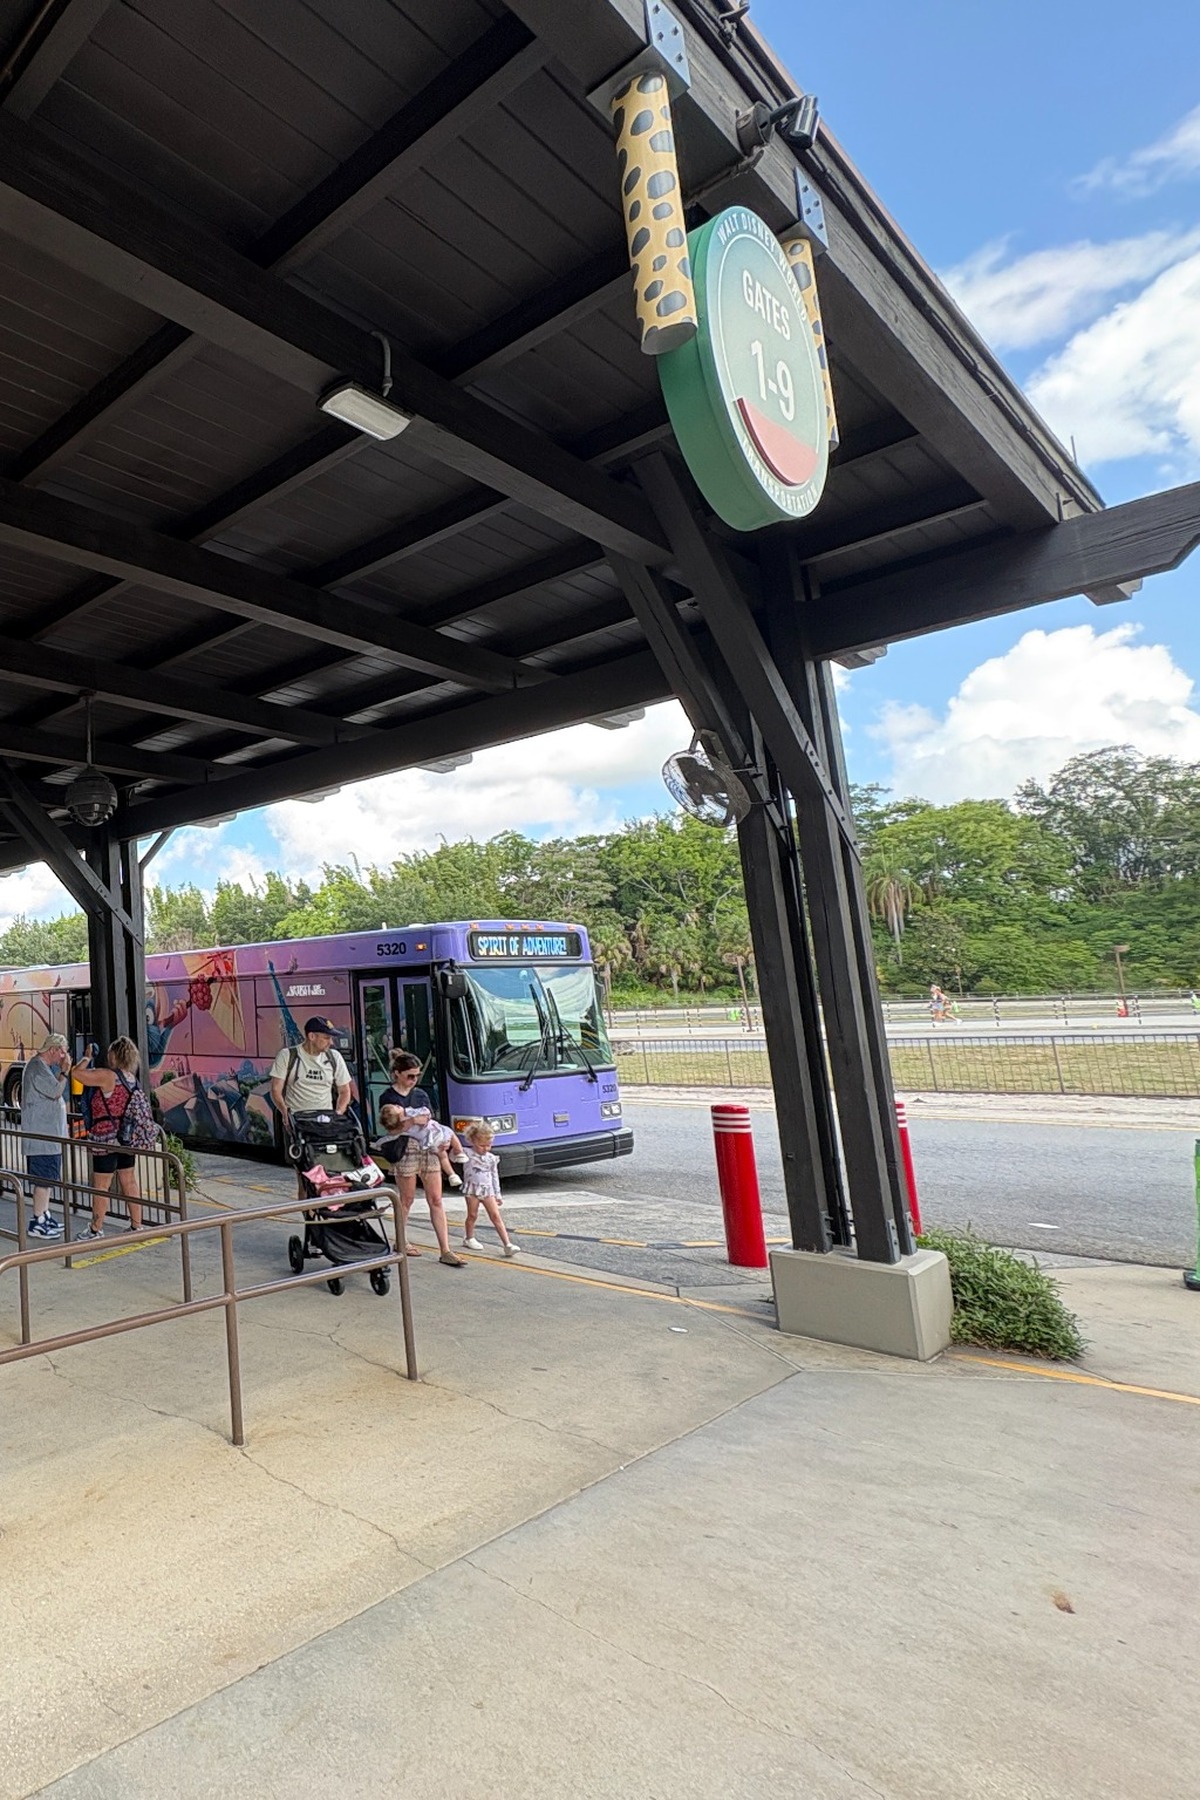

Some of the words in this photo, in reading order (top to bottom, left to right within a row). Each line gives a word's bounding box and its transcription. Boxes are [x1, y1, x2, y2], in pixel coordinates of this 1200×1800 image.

[717, 213, 740, 245] WALT
[741, 212, 776, 252] DISNEY
[779, 252, 808, 321] WORLD
[742, 270, 791, 340] GATES
[751, 340, 795, 422] 1-9
[742, 436, 818, 512] TRANSPORTATION
[377, 942, 407, 956] 5320
[478, 936, 507, 955] SPIRIT
[509, 936, 520, 955] OF
[602, 1083, 617, 1093] 5320
